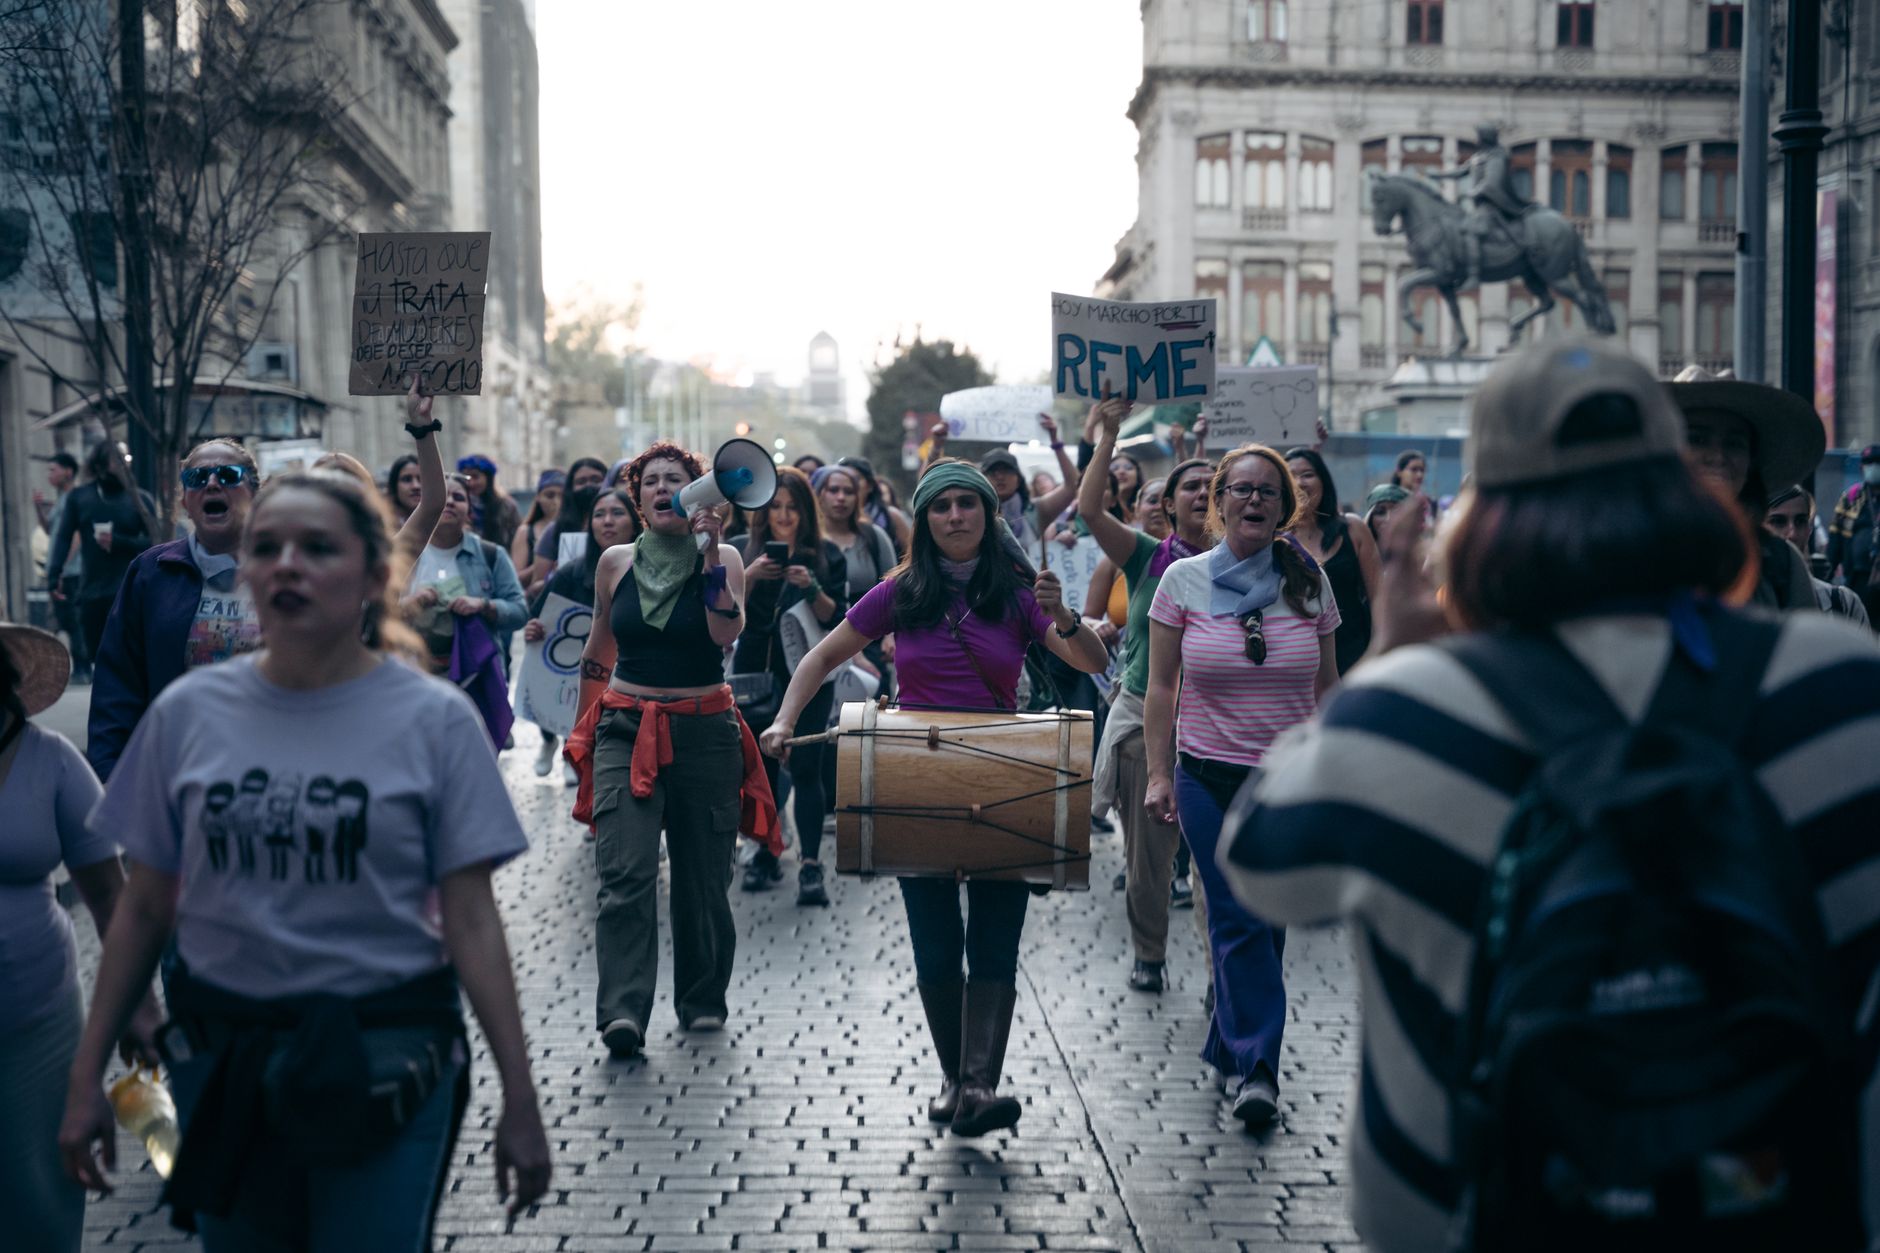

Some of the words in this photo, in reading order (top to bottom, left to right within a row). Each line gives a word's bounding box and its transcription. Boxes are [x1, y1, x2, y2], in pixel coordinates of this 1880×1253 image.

[388, 277, 469, 314] TRATA
[1052, 300, 1082, 317] HOY
[1087, 304, 1151, 324] MARCHO
[1153, 306, 1186, 322] POR
[1188, 305, 1207, 321] TI
[386, 314, 480, 352] MUJERES
[1056, 333, 1207, 401] REME
[543, 606, 593, 676] 8
